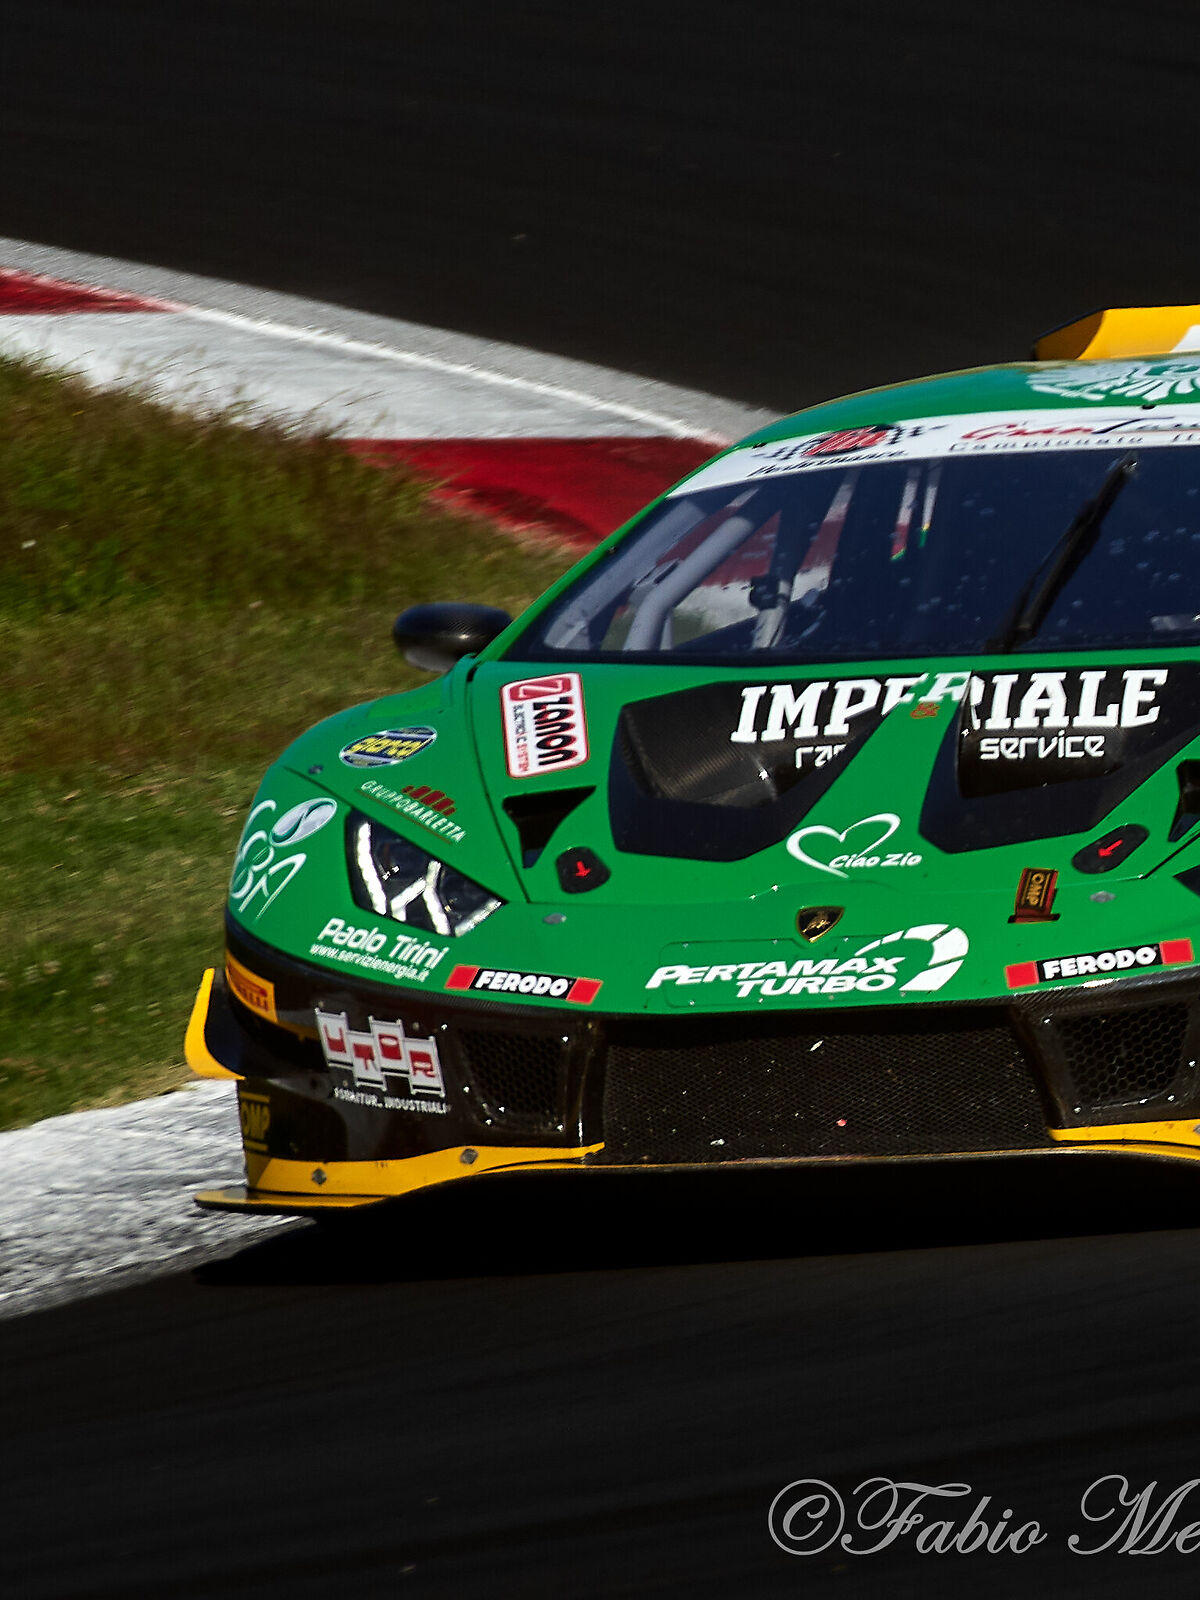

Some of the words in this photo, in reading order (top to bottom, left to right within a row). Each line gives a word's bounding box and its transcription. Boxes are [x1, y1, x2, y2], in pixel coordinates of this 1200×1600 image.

[730, 669, 1168, 743] IMPERIALE
[979, 729, 1105, 760] service
[829, 853, 880, 869] Ciao
[880, 851, 923, 868] Zio
[317, 917, 387, 951] Paolo
[389, 934, 450, 970] Tirini
[645, 955, 906, 989] PERTAMAX
[1042, 948, 1158, 980] FERODO
[475, 970, 569, 998] FERODO
[735, 972, 899, 998] TURBO
